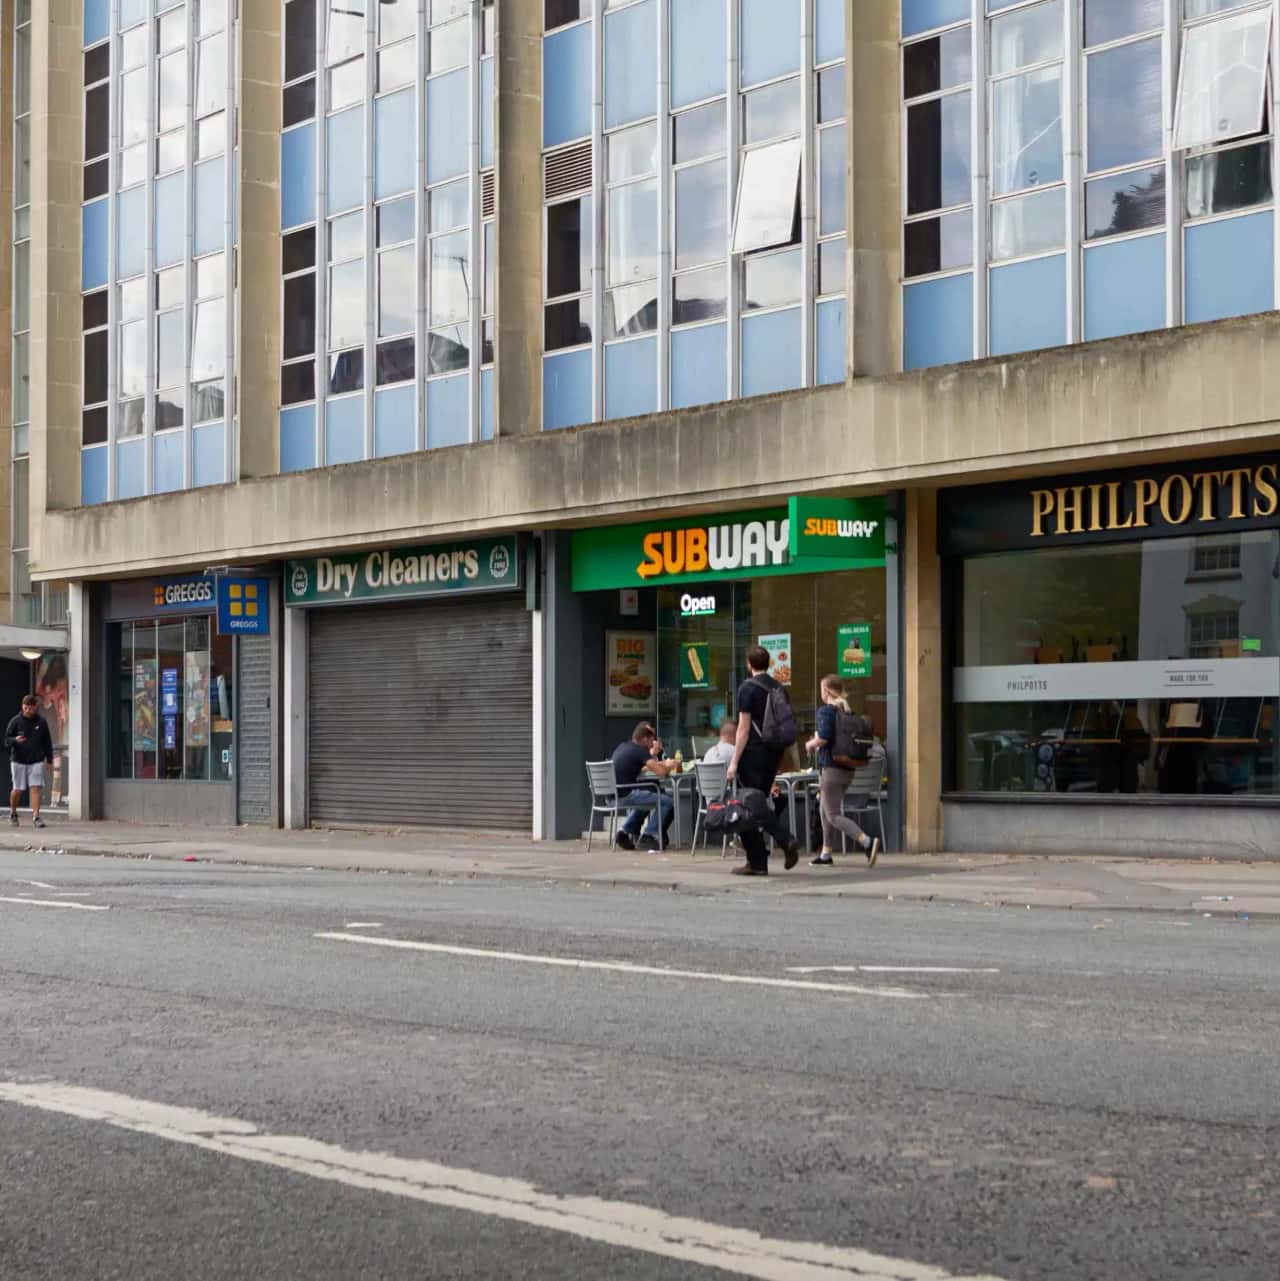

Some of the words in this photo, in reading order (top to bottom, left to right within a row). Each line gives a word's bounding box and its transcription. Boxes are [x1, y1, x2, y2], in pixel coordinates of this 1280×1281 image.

[1029, 463, 1279, 537] PHILPOTTS
[803, 517, 876, 538] SUBWAY
[636, 518, 791, 580] SUBWAY
[316, 557, 359, 598] Dry
[364, 548, 480, 588] Cleaners
[165, 581, 212, 604] GREGGS
[680, 593, 716, 616] Open
[229, 620, 259, 629] GREGGS
[1007, 679, 1048, 691] PHILPOTTS
